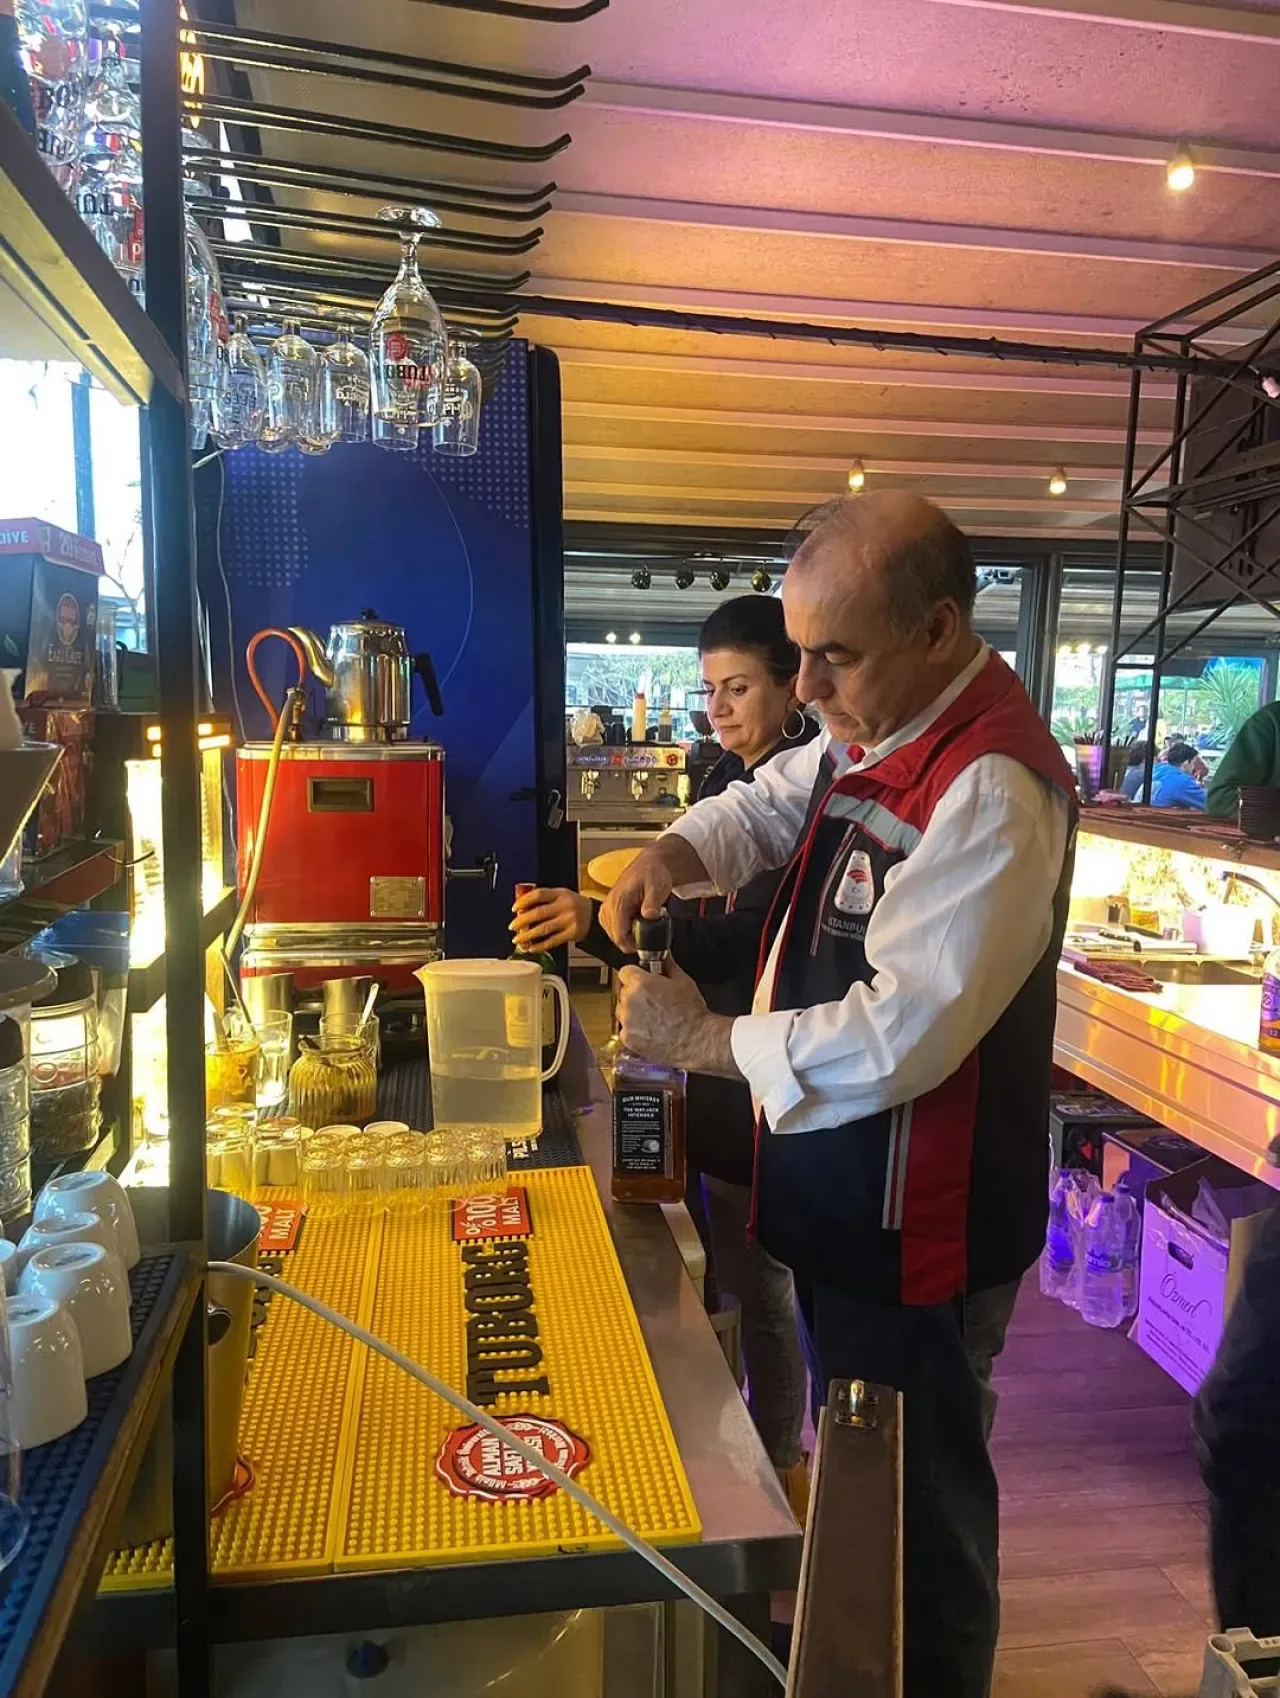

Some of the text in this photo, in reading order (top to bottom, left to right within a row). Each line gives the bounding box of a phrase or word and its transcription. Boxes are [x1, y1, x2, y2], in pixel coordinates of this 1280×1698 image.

[268, 1208, 296, 1240] MALT
[501, 1196, 522, 1226] MALT
[462, 1241, 550, 1405] TUBORG
[481, 1437, 502, 1476] ALMAN
